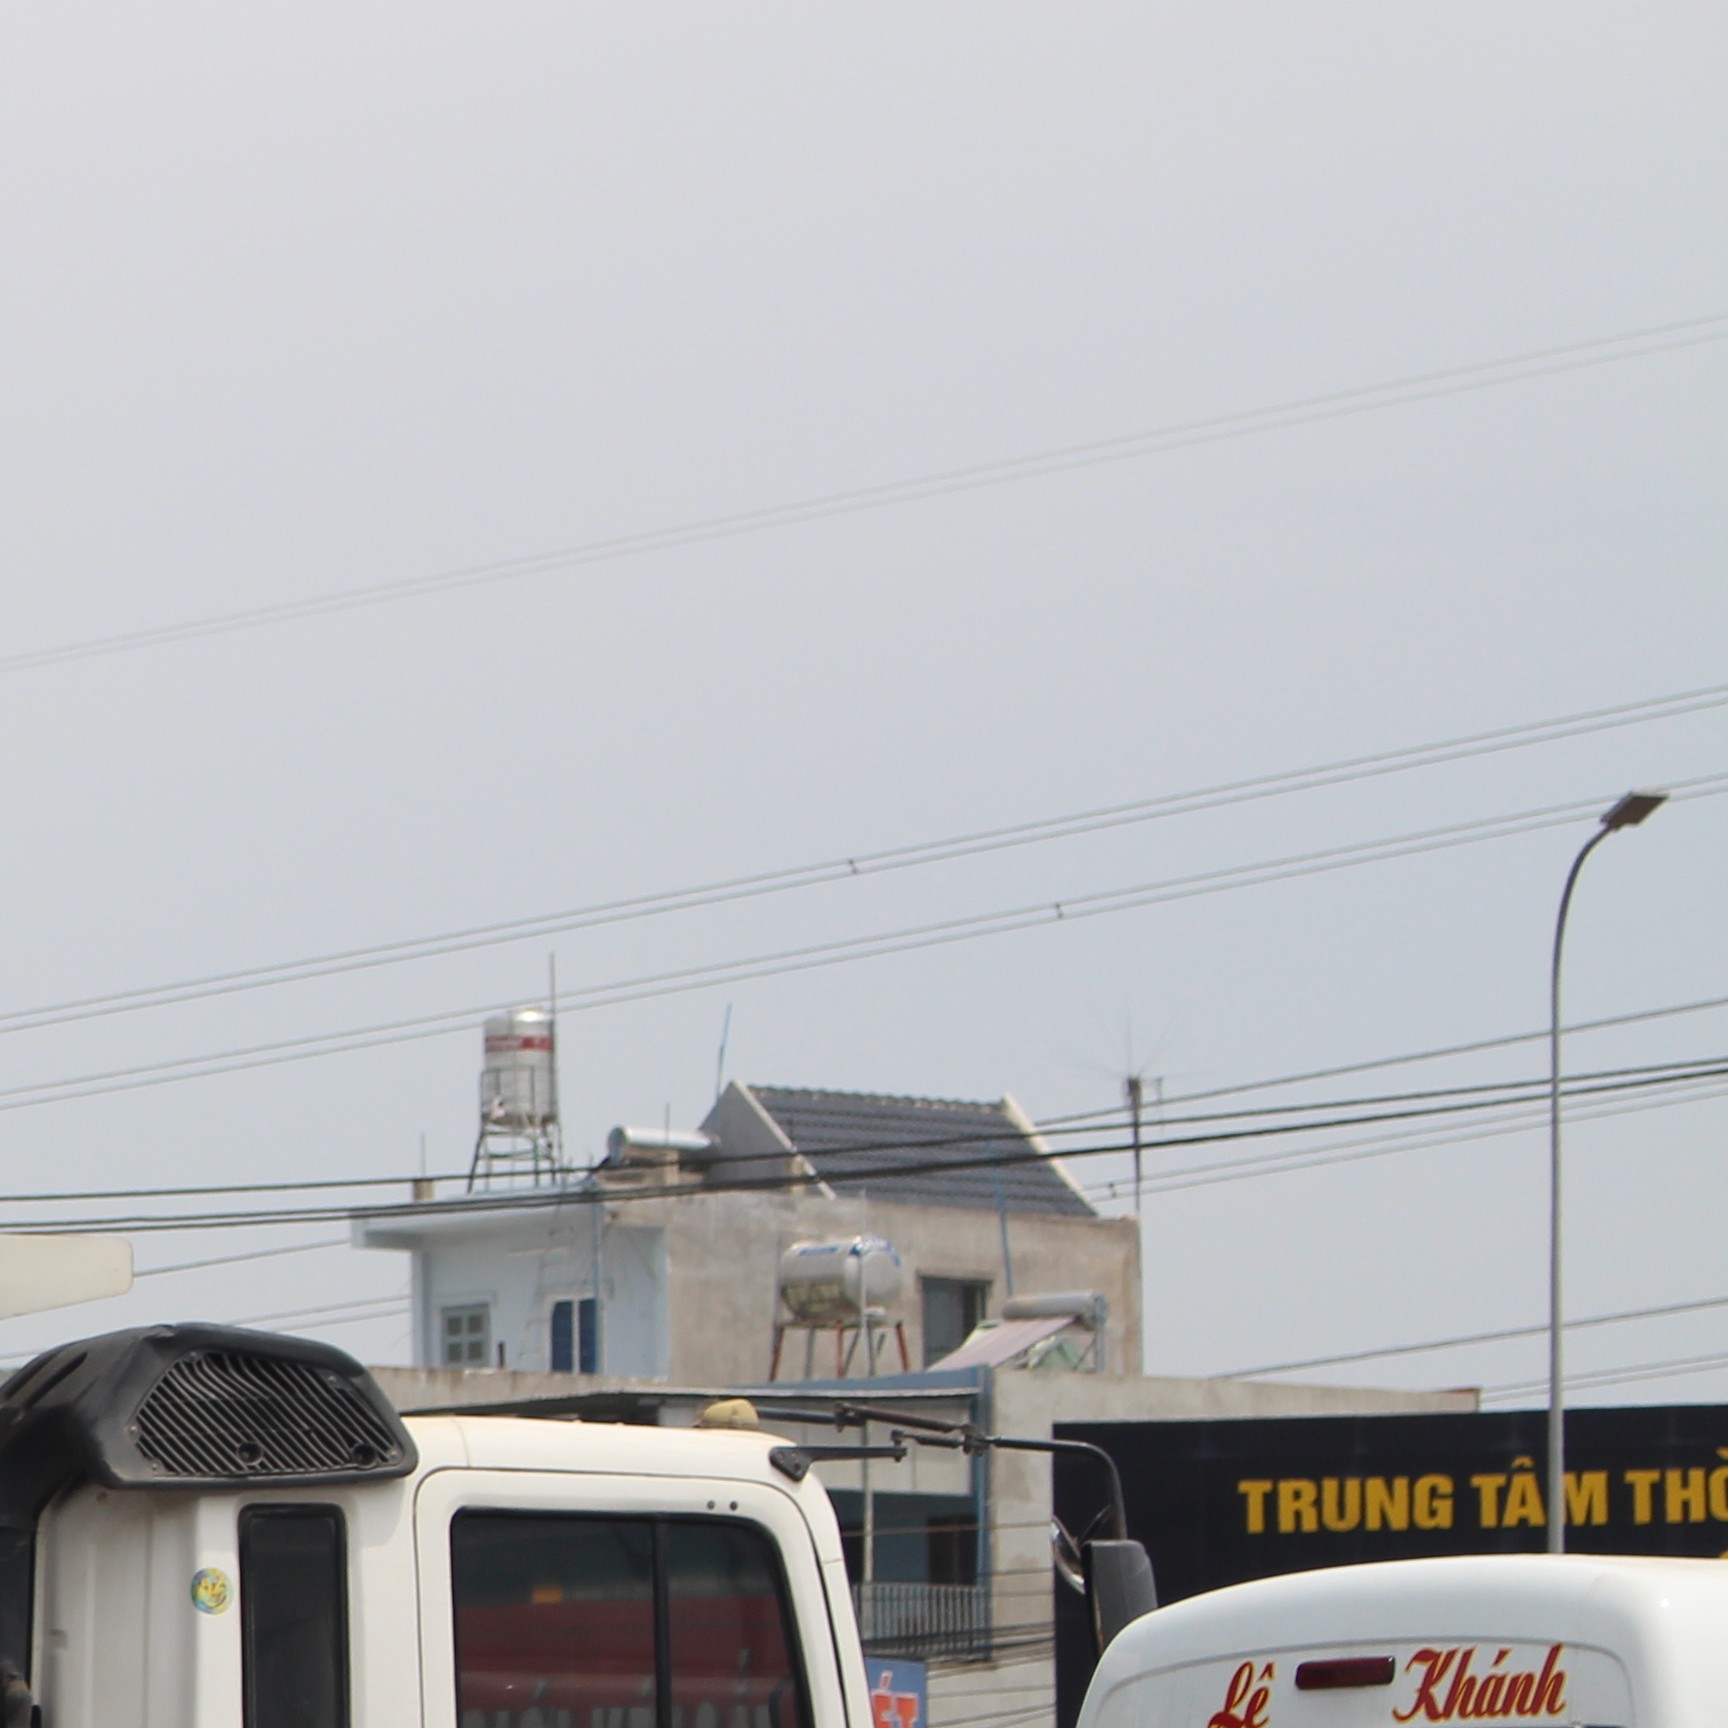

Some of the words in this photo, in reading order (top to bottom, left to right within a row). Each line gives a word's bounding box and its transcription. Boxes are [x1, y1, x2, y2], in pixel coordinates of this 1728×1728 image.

[1238, 1474, 1454, 1534] TRUNG
[1470, 1455, 1608, 1528] TÂM
[1392, 1642, 1566, 1723] Khánh
